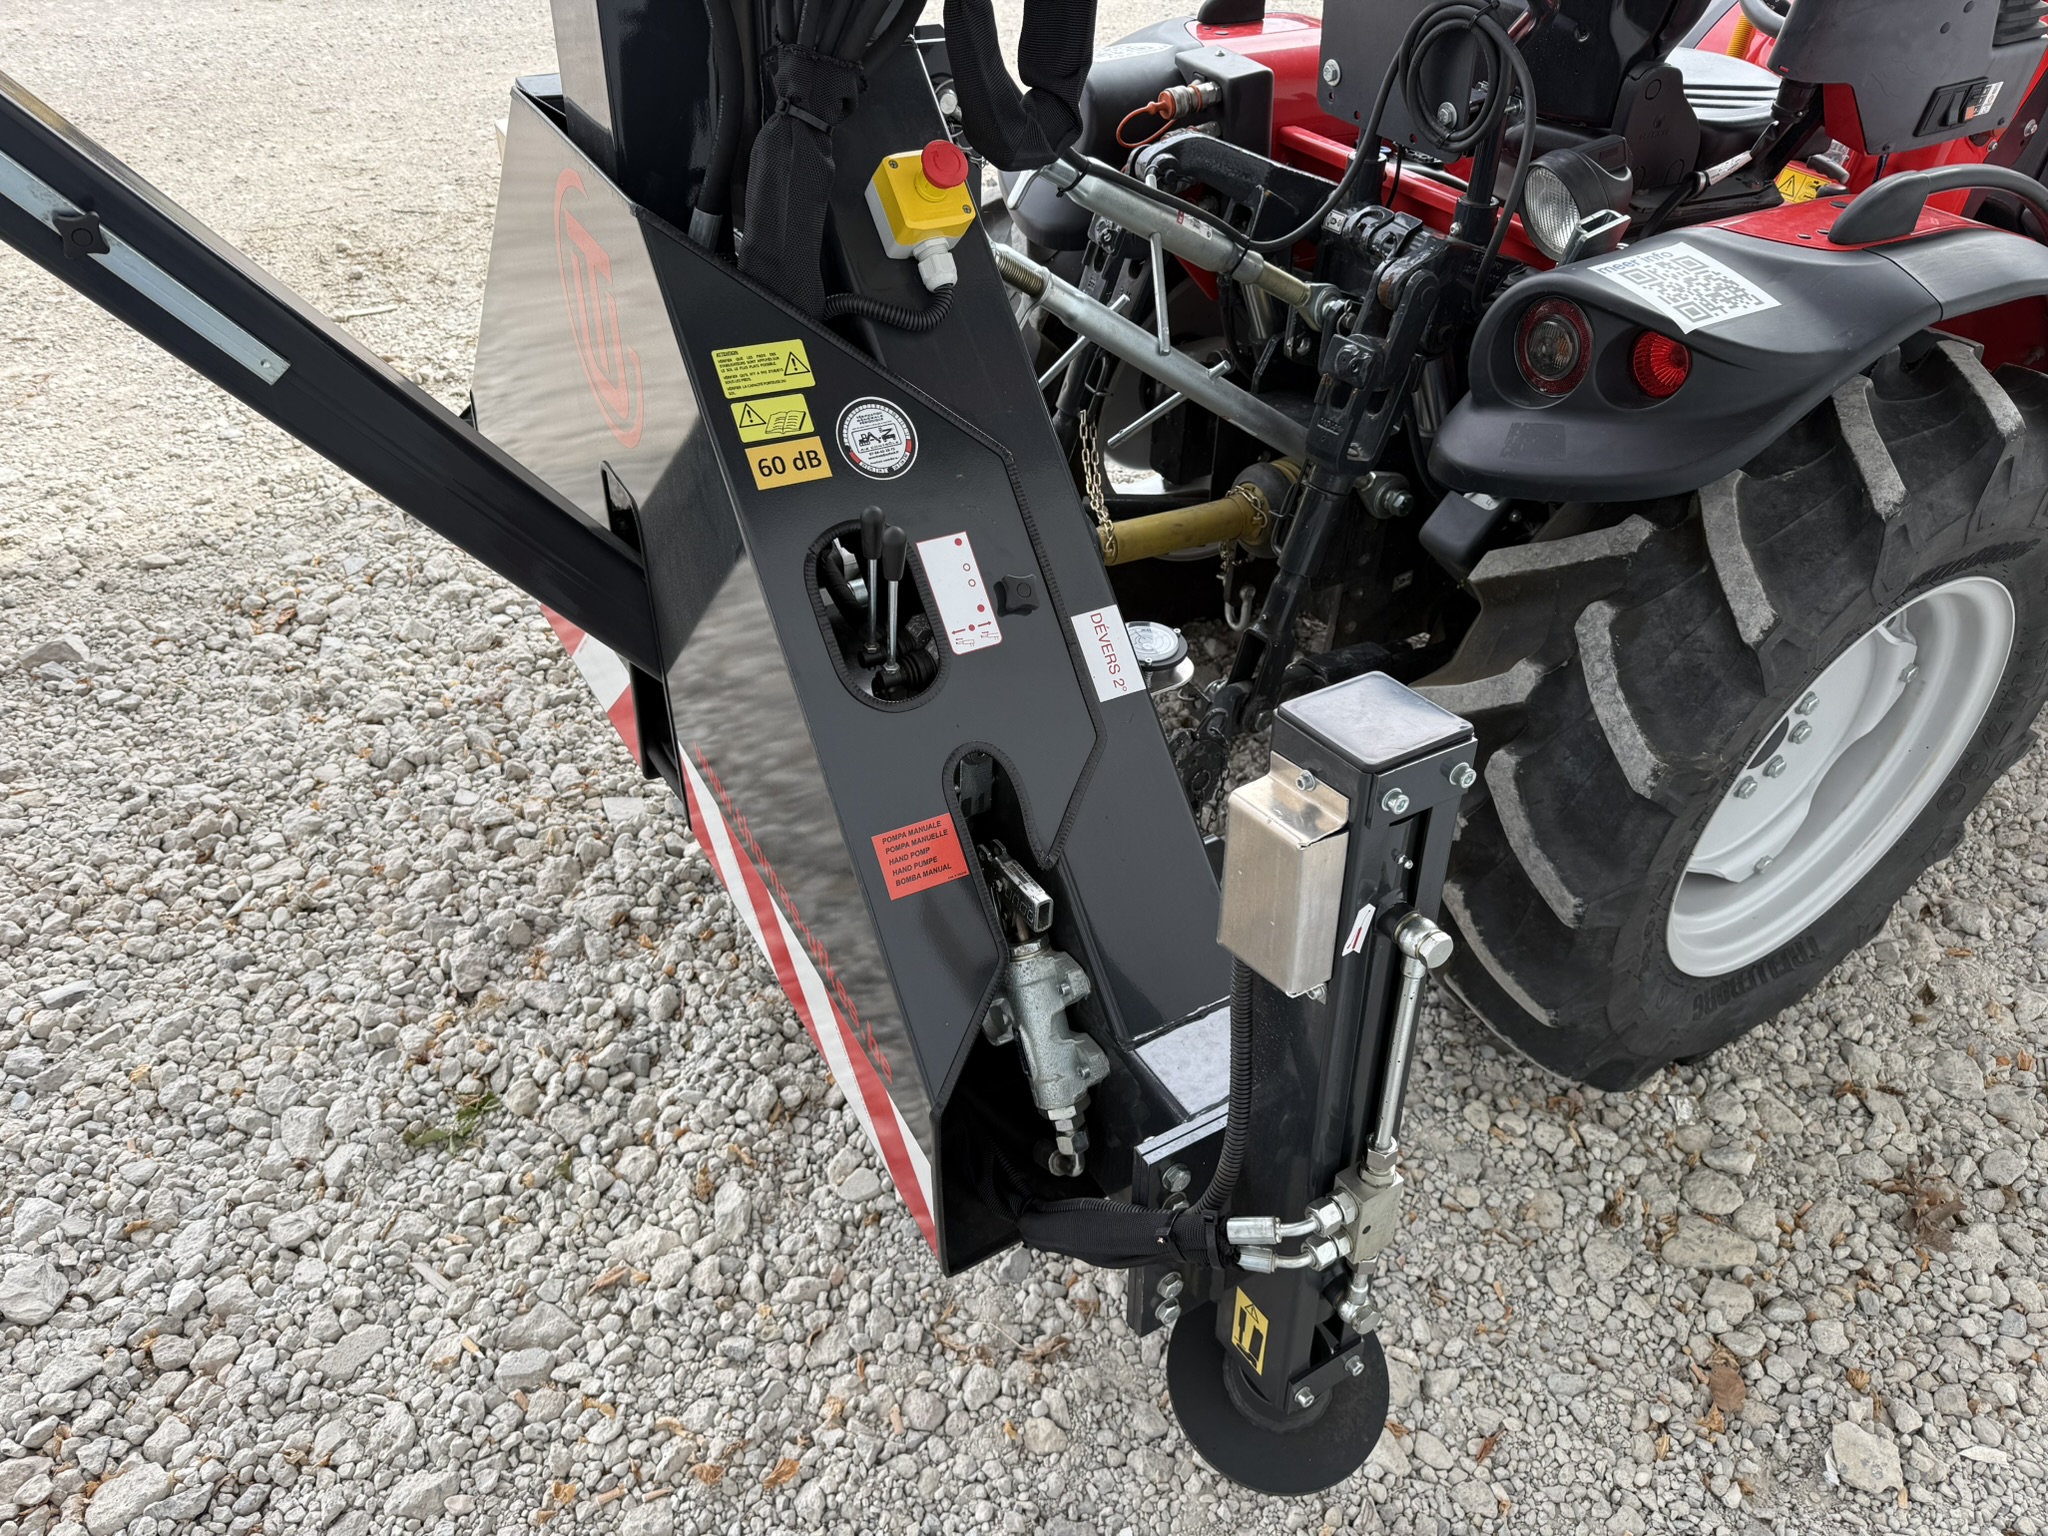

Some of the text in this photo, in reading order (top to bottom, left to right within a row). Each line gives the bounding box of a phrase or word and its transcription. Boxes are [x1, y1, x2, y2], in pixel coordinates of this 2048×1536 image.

[1597, 251, 1674, 274] meer info
[758, 449, 822, 477] 60 dB
[1090, 612, 1121, 675] DÉVERS
[882, 821, 941, 844] POMPA MANUALE
[885, 829, 948, 854] POMPA MANUELLE
[889, 847, 930, 865] HAND POMP
[892, 856, 938, 876] HAND PUMPE
[896, 873, 922, 886] BOMBA
[923, 864, 952, 877] MANUAL
